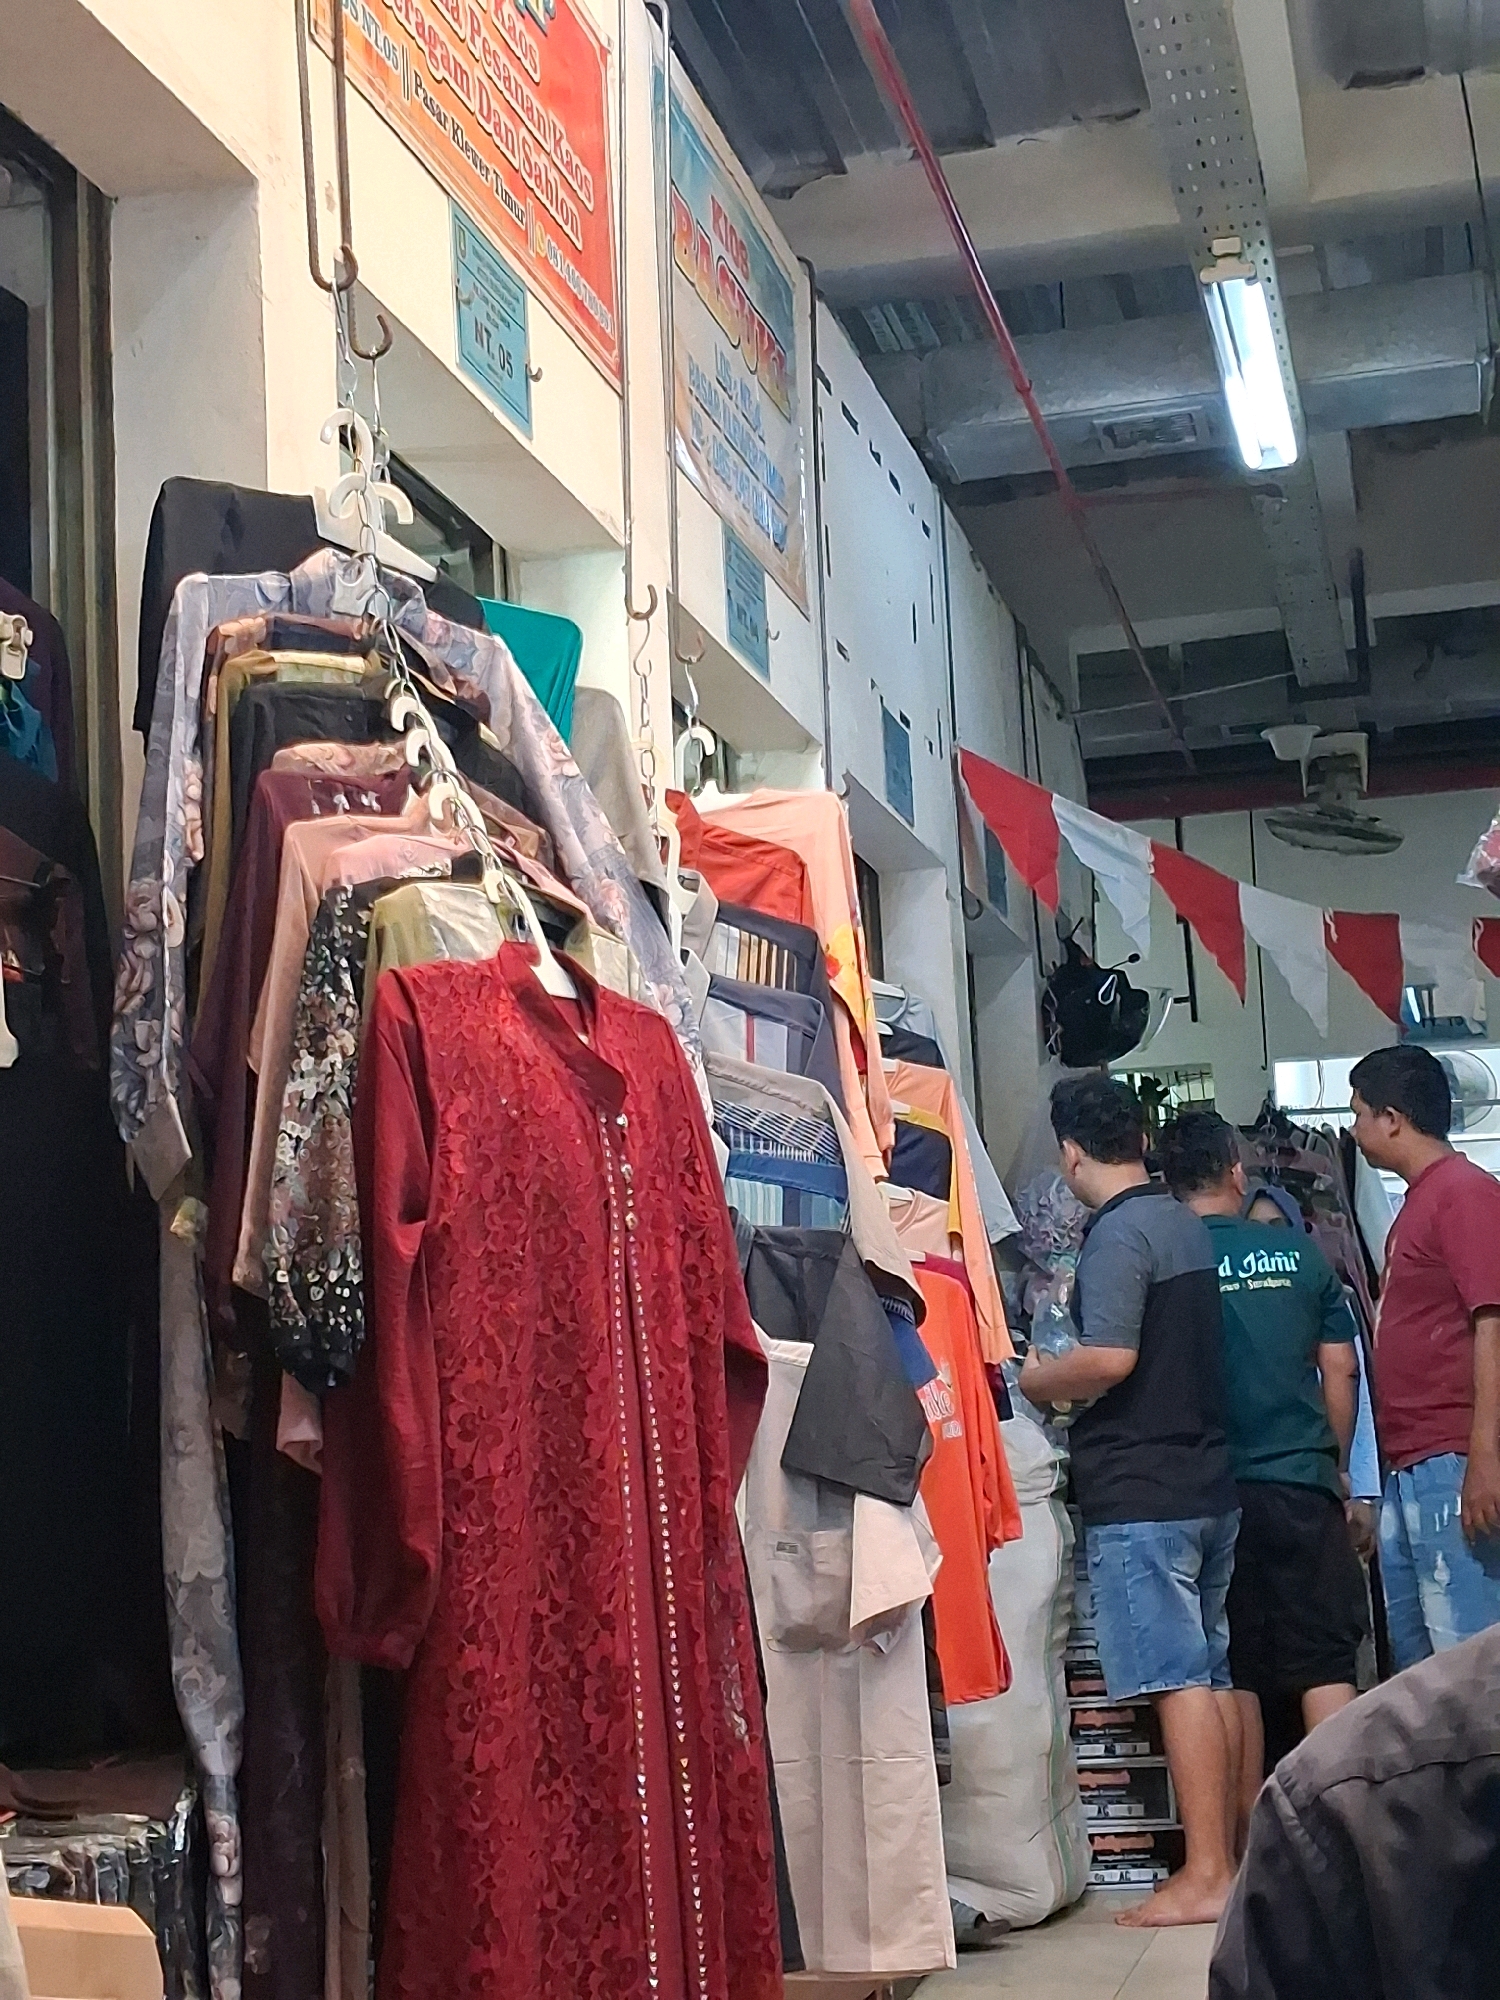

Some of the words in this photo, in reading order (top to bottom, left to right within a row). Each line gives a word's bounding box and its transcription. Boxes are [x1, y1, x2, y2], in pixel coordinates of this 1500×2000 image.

[414, 70, 449, 131] Pasar
[451, 117, 490, 183] Klewer
[493, 170, 526, 226] Timur
[468, 4, 550, 142] Pesanan
[551, 118, 592, 206] Kaos
[476, 76, 517, 159] Dan
